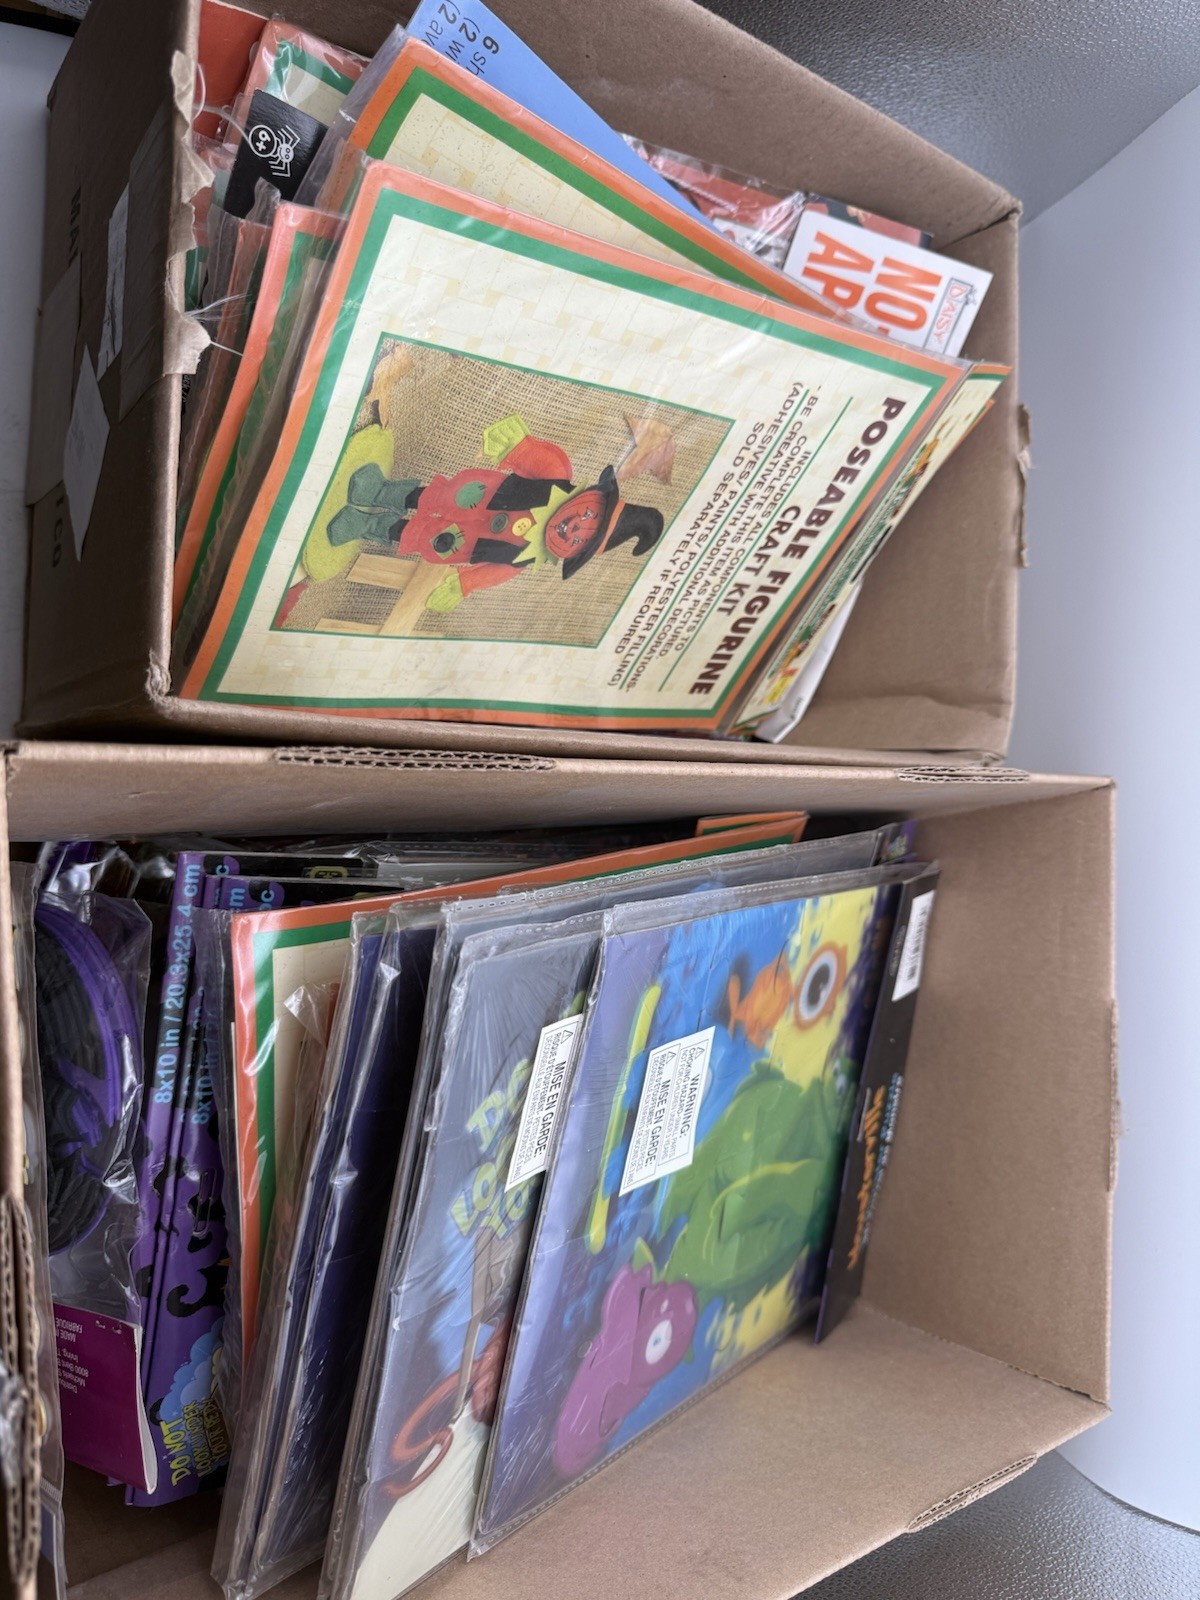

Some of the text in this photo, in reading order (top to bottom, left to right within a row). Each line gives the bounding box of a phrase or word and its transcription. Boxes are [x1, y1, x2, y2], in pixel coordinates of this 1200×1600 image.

[458, 17, 481, 43] (2
[482, 36, 499, 55] 6
[933, 282, 969, 345] DAISY
[799, 395, 818, 416] BE
[751, 436, 806, 511] COMPLETE
[753, 422, 801, 489] CREATIVE
[614, 422, 764, 652] SOLD SEPARATELY IF REQUIRED
[695, 490, 737, 547] PAINTS/
[728, 494, 756, 525] WITH
[731, 514, 756, 543] THIS
[674, 450, 811, 650] INCLUDES ALL COMPONENTS TO
[678, 529, 728, 603] ADDITIONAL
[688, 396, 905, 697] POSEABLE FIGURINE
[708, 546, 733, 575] ITEM
[716, 507, 800, 616] CRAFT KIT
[642, 551, 697, 630] POLYESTER
[697, 579, 709, 595] AS
[607, 635, 645, 686] FILLING)
[184, 864, 201, 898] cm
[160, 1028, 180, 1047] in
[153, 1053, 177, 1103] 8x10
[533, 1059, 566, 1158] MISE EN GARDE:
[678, 1073, 699, 1139] WARNING:
[644, 1078, 671, 1168] MISE EN GARDE:
[160, 1418, 192, 1486] DO NOT
